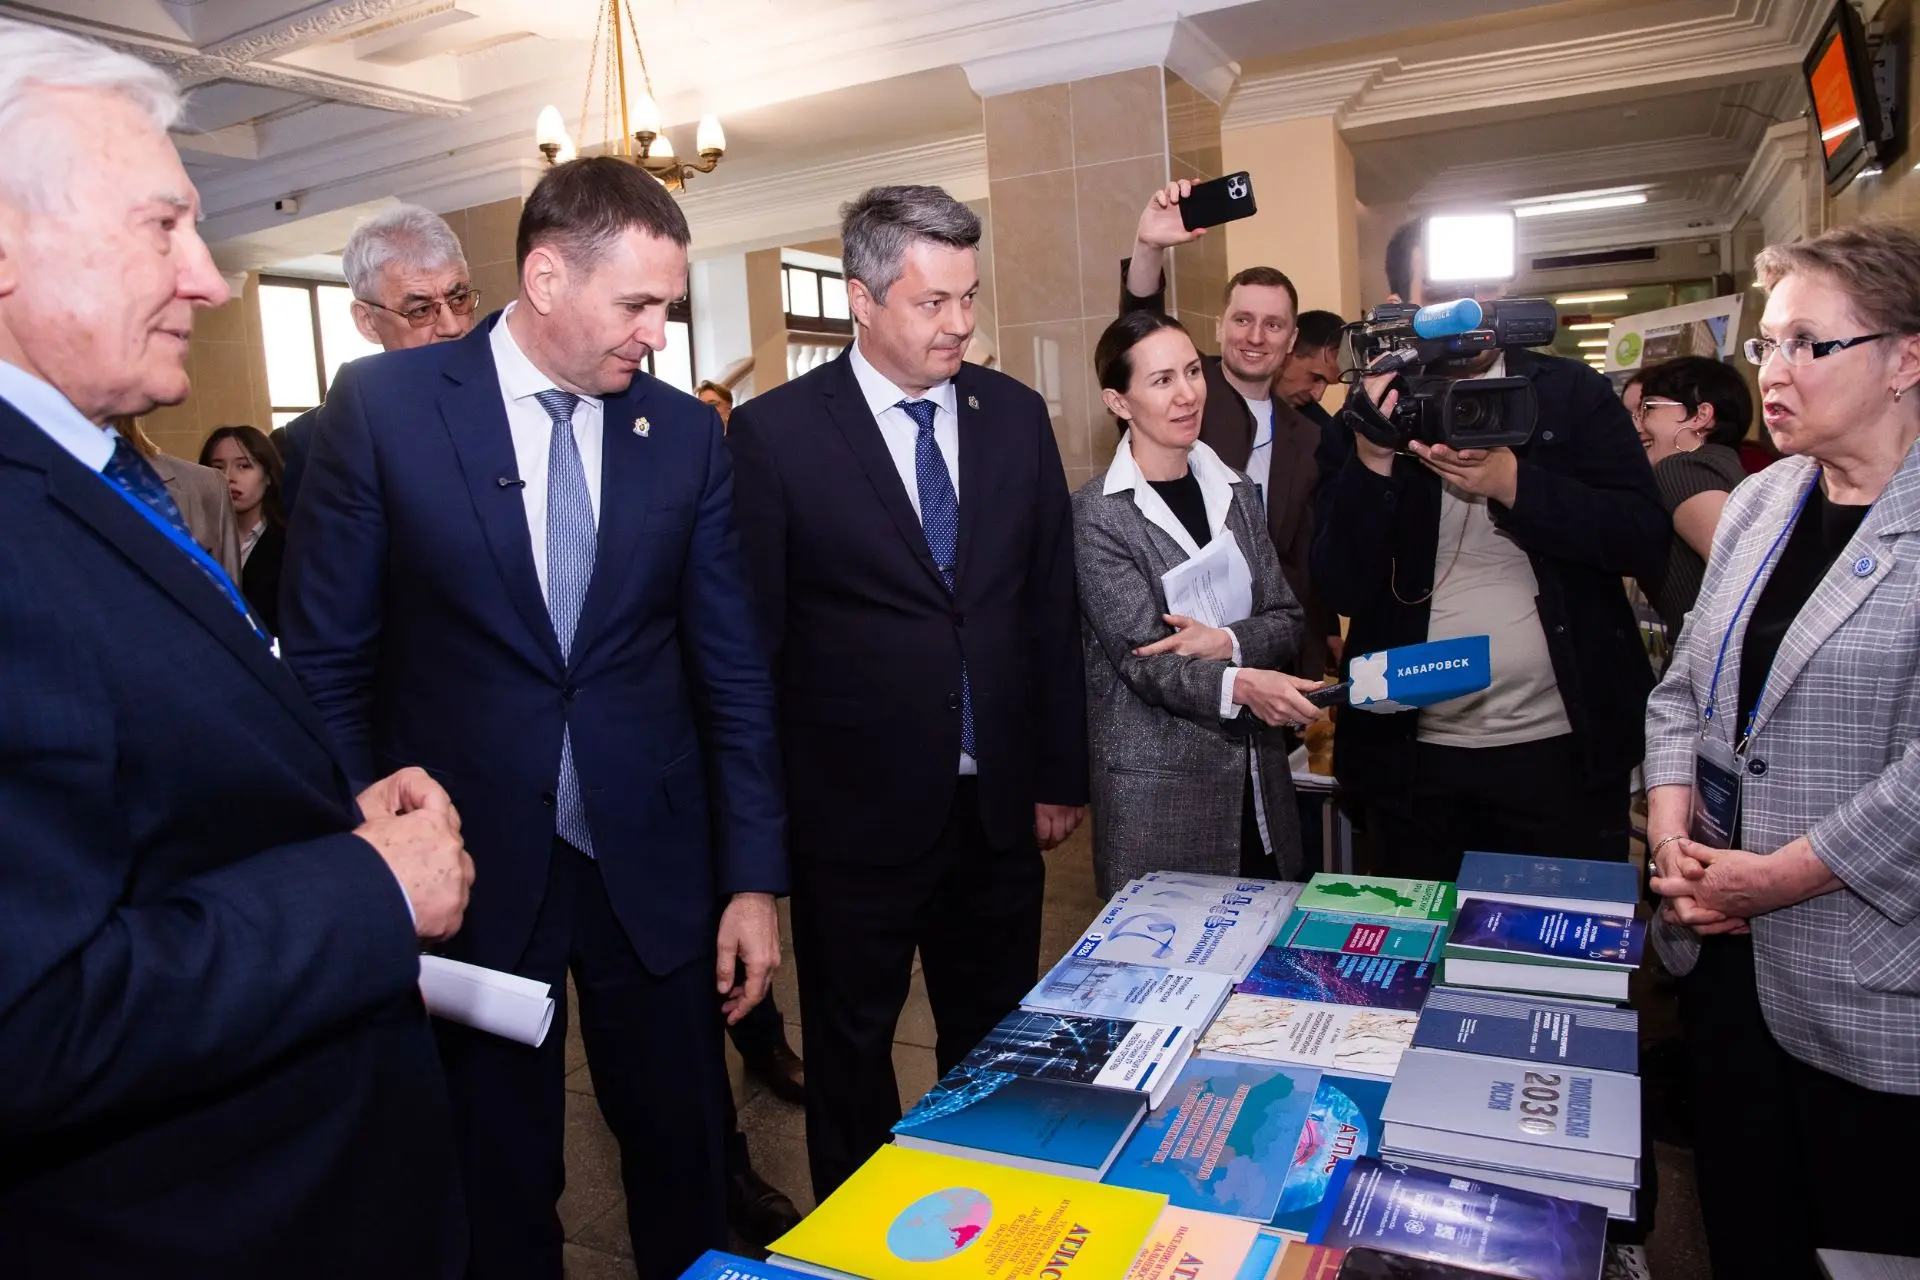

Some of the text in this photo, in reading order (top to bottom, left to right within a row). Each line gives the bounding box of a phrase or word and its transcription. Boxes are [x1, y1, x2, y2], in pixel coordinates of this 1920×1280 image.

[1397, 657, 1470, 678] ХАБАРОВСК
[1100, 916, 1116, 924] 22
[1073, 941, 1097, 957] 2026
[1490, 1080, 1515, 1111] РОССИЯ
[1520, 1071, 1562, 1136] 2030
[1566, 1076, 1593, 1138] ТИХООКЕАНСКАЯ
[982, 1213, 1027, 1264] ФЕДЕРАЛЬНОГО
[983, 1223, 1010, 1248] ОКРУГА
[985, 1206, 1043, 1275] ДАЛЬНЕВОСТОЧНОГО
[1006, 1223, 1042, 1263] НАСЕЛЕНИЯ
[1038, 1222, 1093, 1280] АТЛАС
[1158, 1226, 1189, 1263] НАСЕЛЕНИЕ
